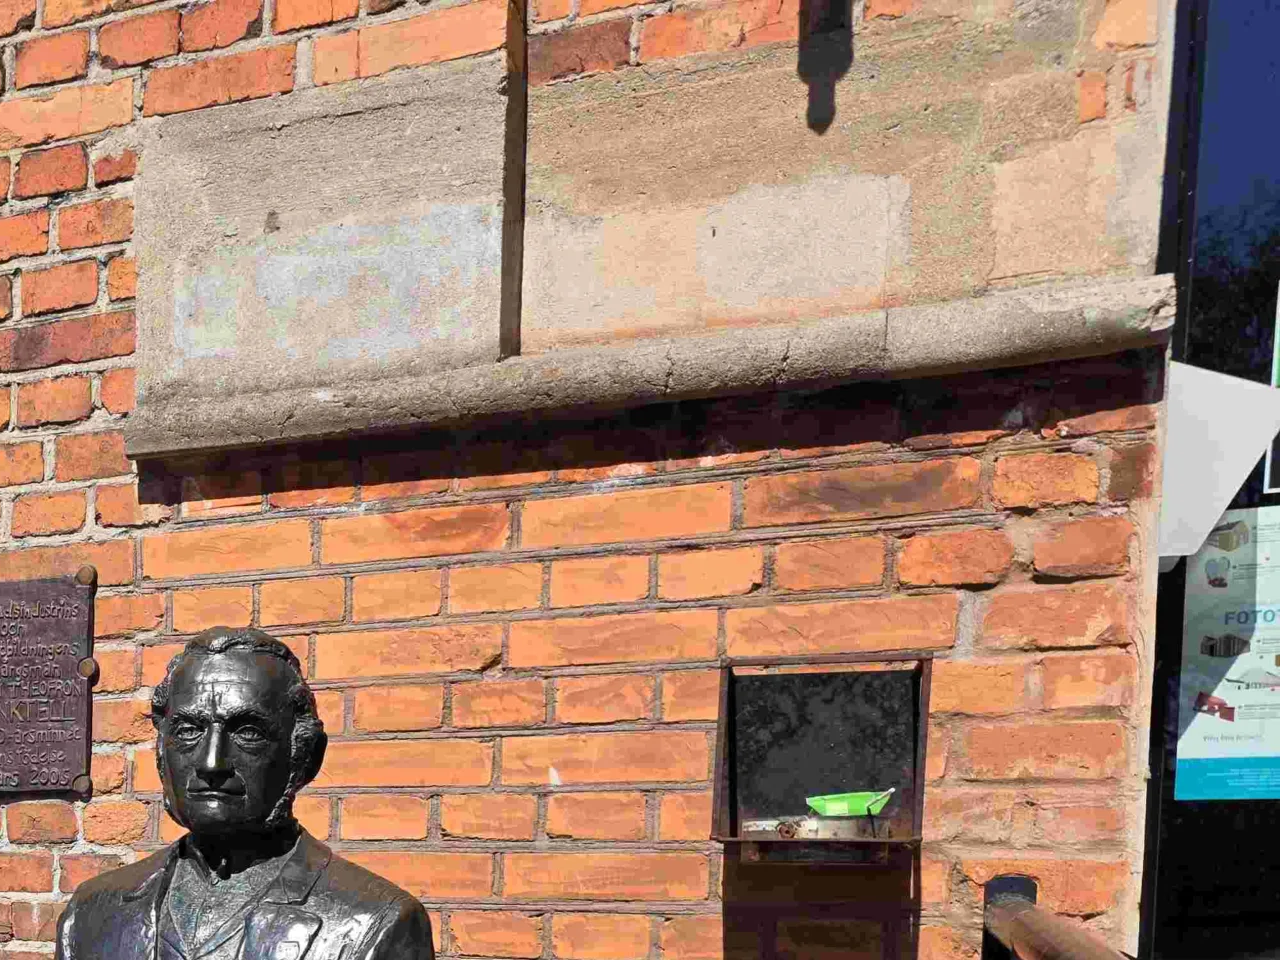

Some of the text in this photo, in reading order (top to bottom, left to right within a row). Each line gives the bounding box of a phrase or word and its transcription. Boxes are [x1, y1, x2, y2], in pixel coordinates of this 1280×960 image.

[1224, 609, 1280, 625] FOTO
[8, 679, 84, 701] THEOFRON
[29, 767, 71, 786] 2005
